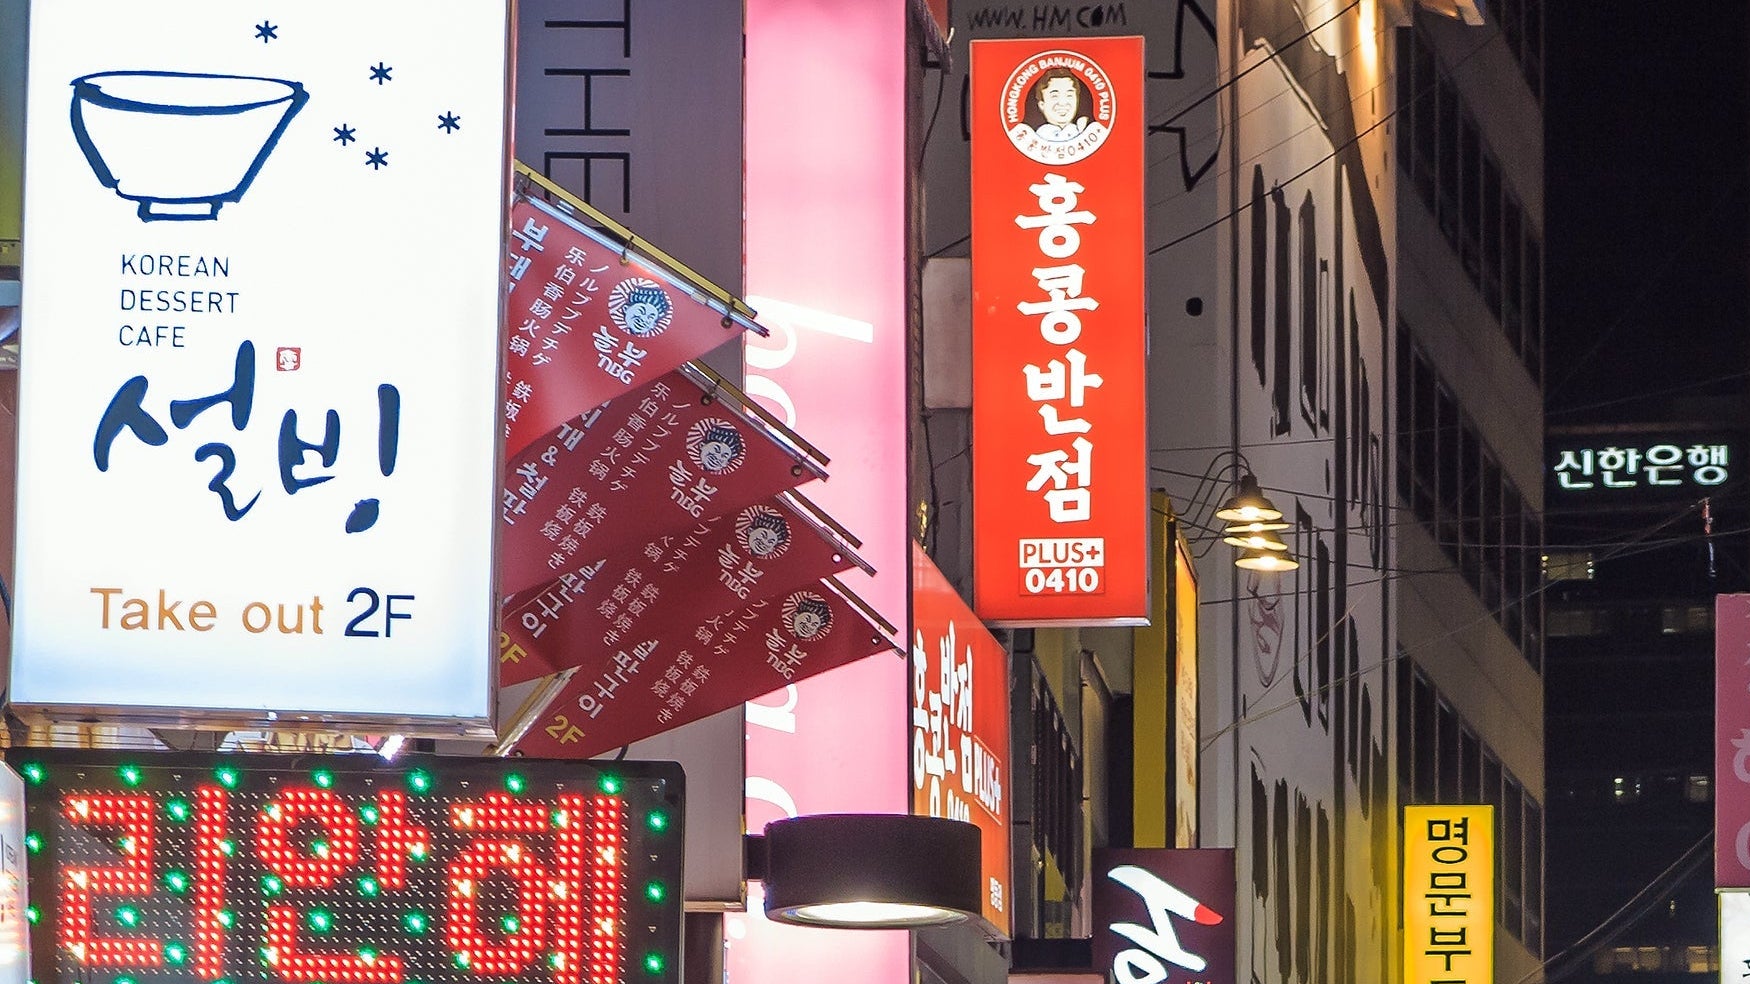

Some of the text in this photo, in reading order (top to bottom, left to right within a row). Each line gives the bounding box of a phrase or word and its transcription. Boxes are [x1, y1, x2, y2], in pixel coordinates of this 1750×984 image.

[1006, 56, 1112, 124] HONGKONG BANJUM 0410 PLUS
[121, 254, 231, 279] KOREAN
[120, 290, 241, 315] DESSERT
[118, 325, 187, 348] CAFE
[592, 325, 648, 369] 놀부
[1014, 173, 1105, 524] 홍콩반점
[93, 340, 401, 534] 설빙
[668, 459, 719, 504] 놀부
[1554, 443, 1730, 490] 신한은행
[717, 543, 765, 587] 놀부
[1024, 568, 1100, 593] 0410
[90, 587, 416, 638] Take out 2F
[765, 628, 809, 668] 놀부
[544, 714, 587, 746] 2F
